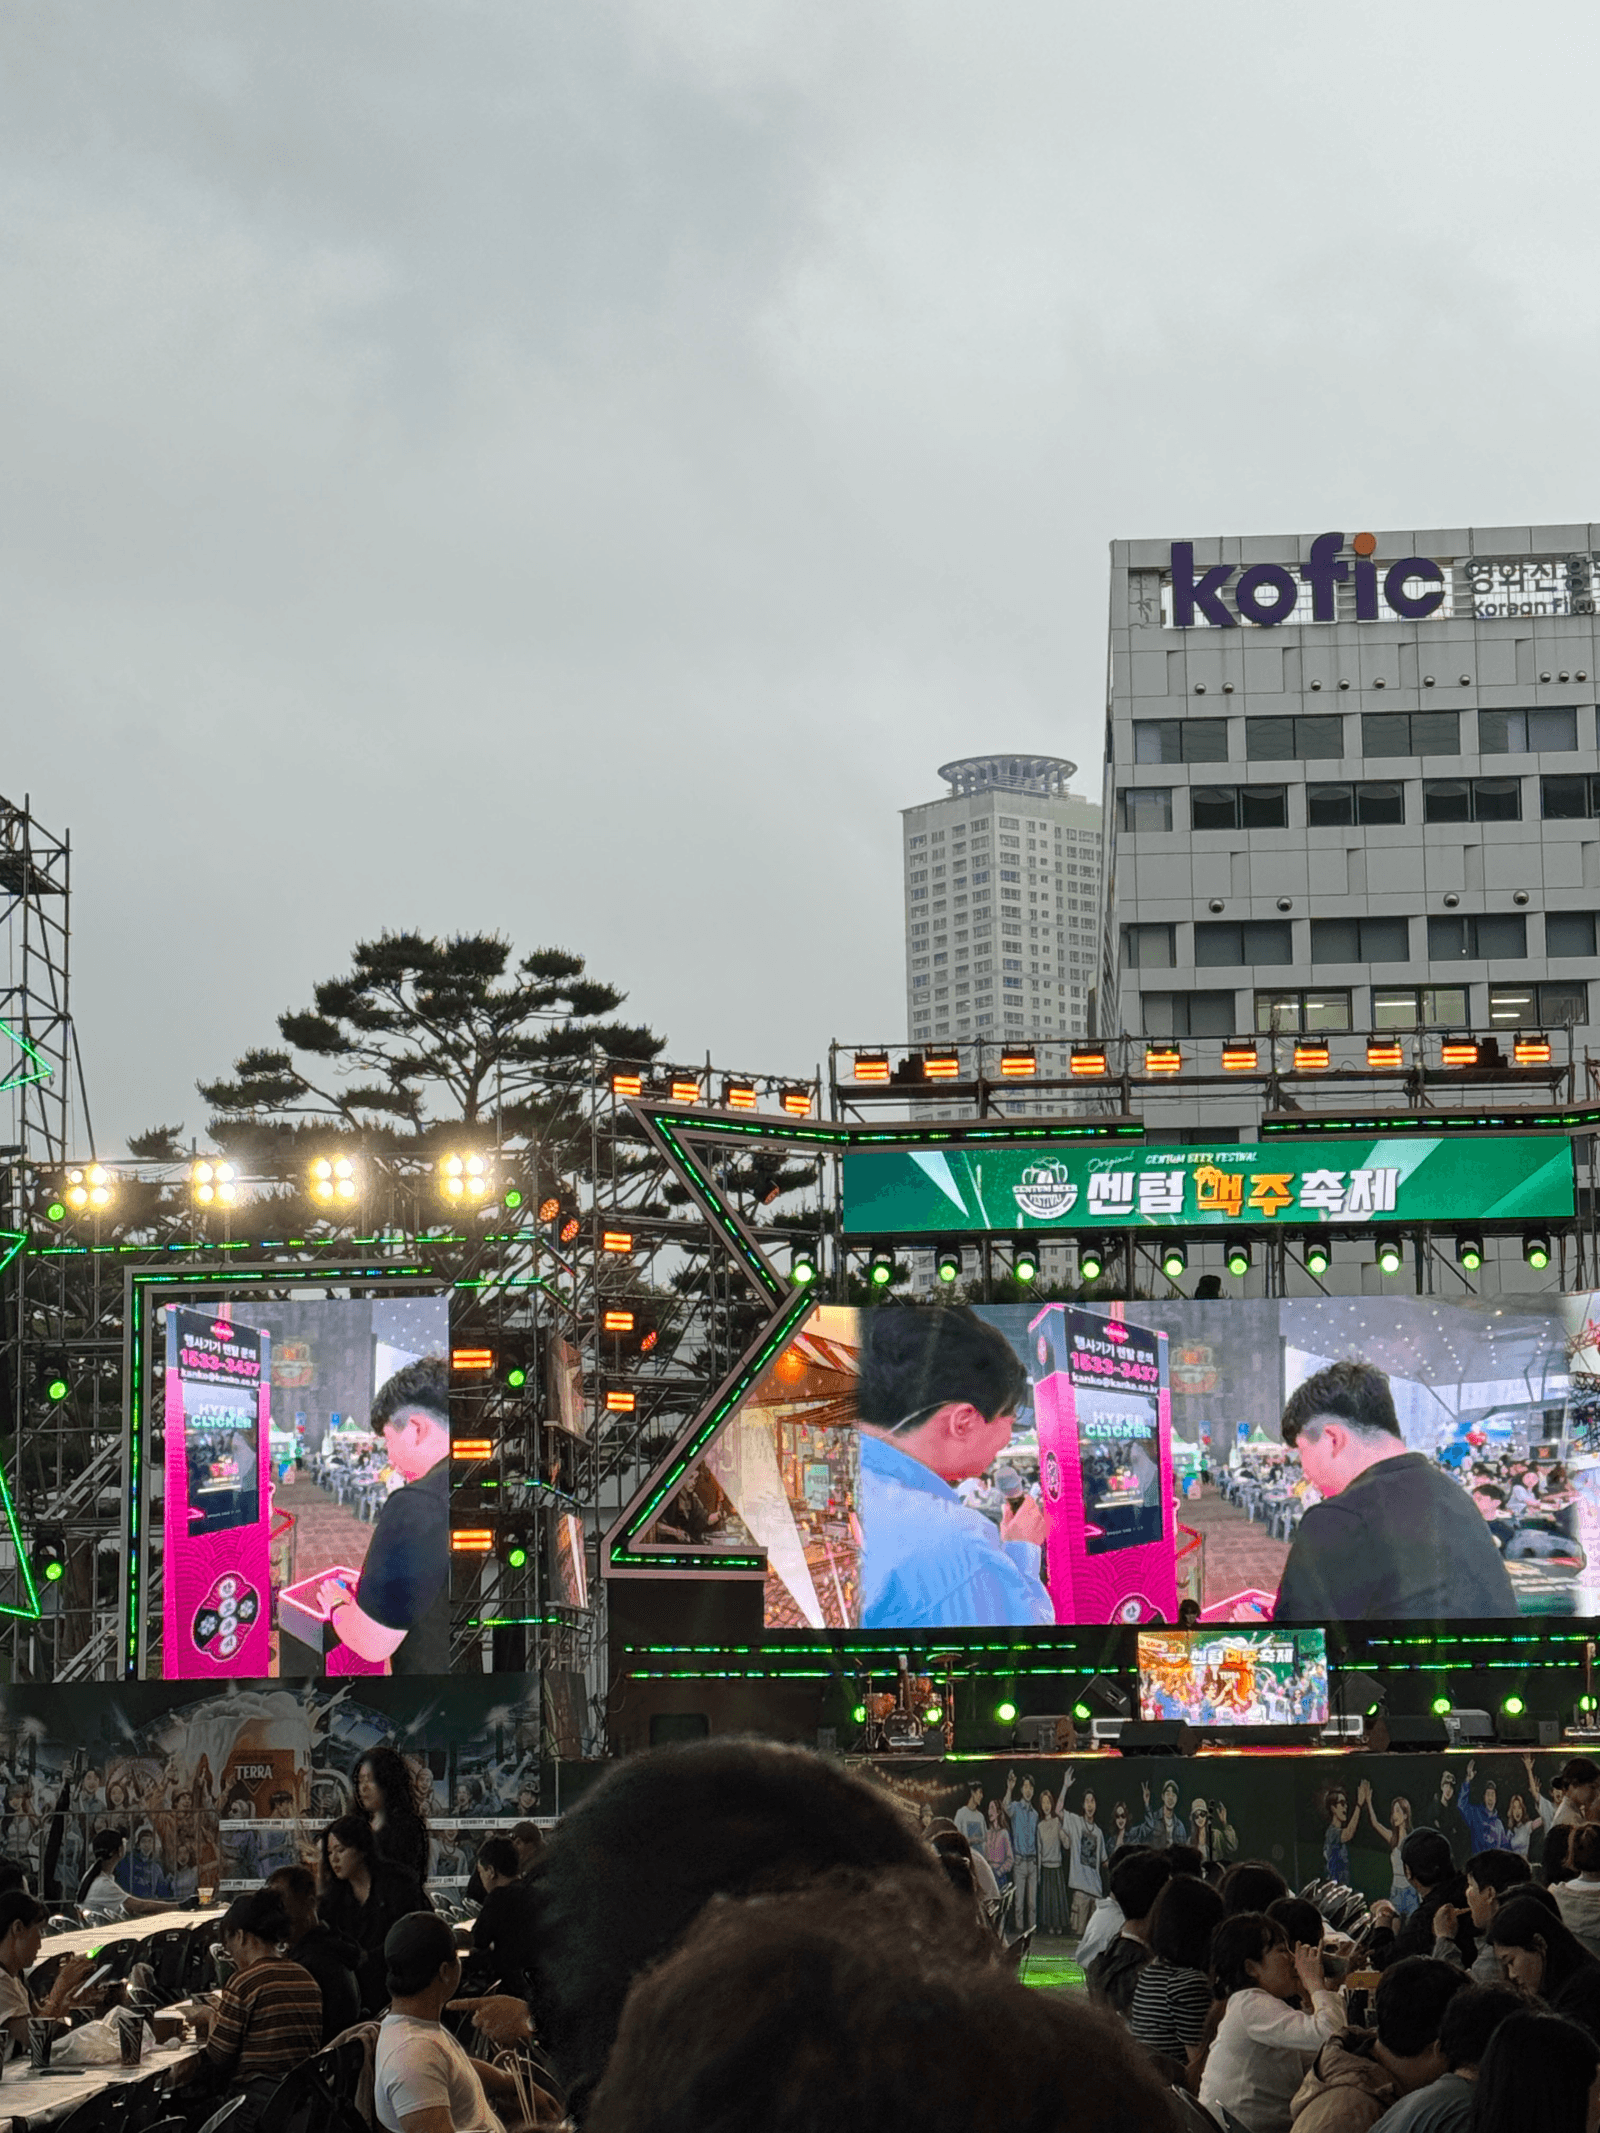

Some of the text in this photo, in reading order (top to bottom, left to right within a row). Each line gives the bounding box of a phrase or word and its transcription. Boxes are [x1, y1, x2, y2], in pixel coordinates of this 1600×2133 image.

[1170, 532, 1446, 627] kofic
[1473, 599, 1547, 617] Korean
[1145, 1151, 1258, 1165] CENTUM BEER FESTIVAL
[233, 1764, 274, 1781] TERRA
